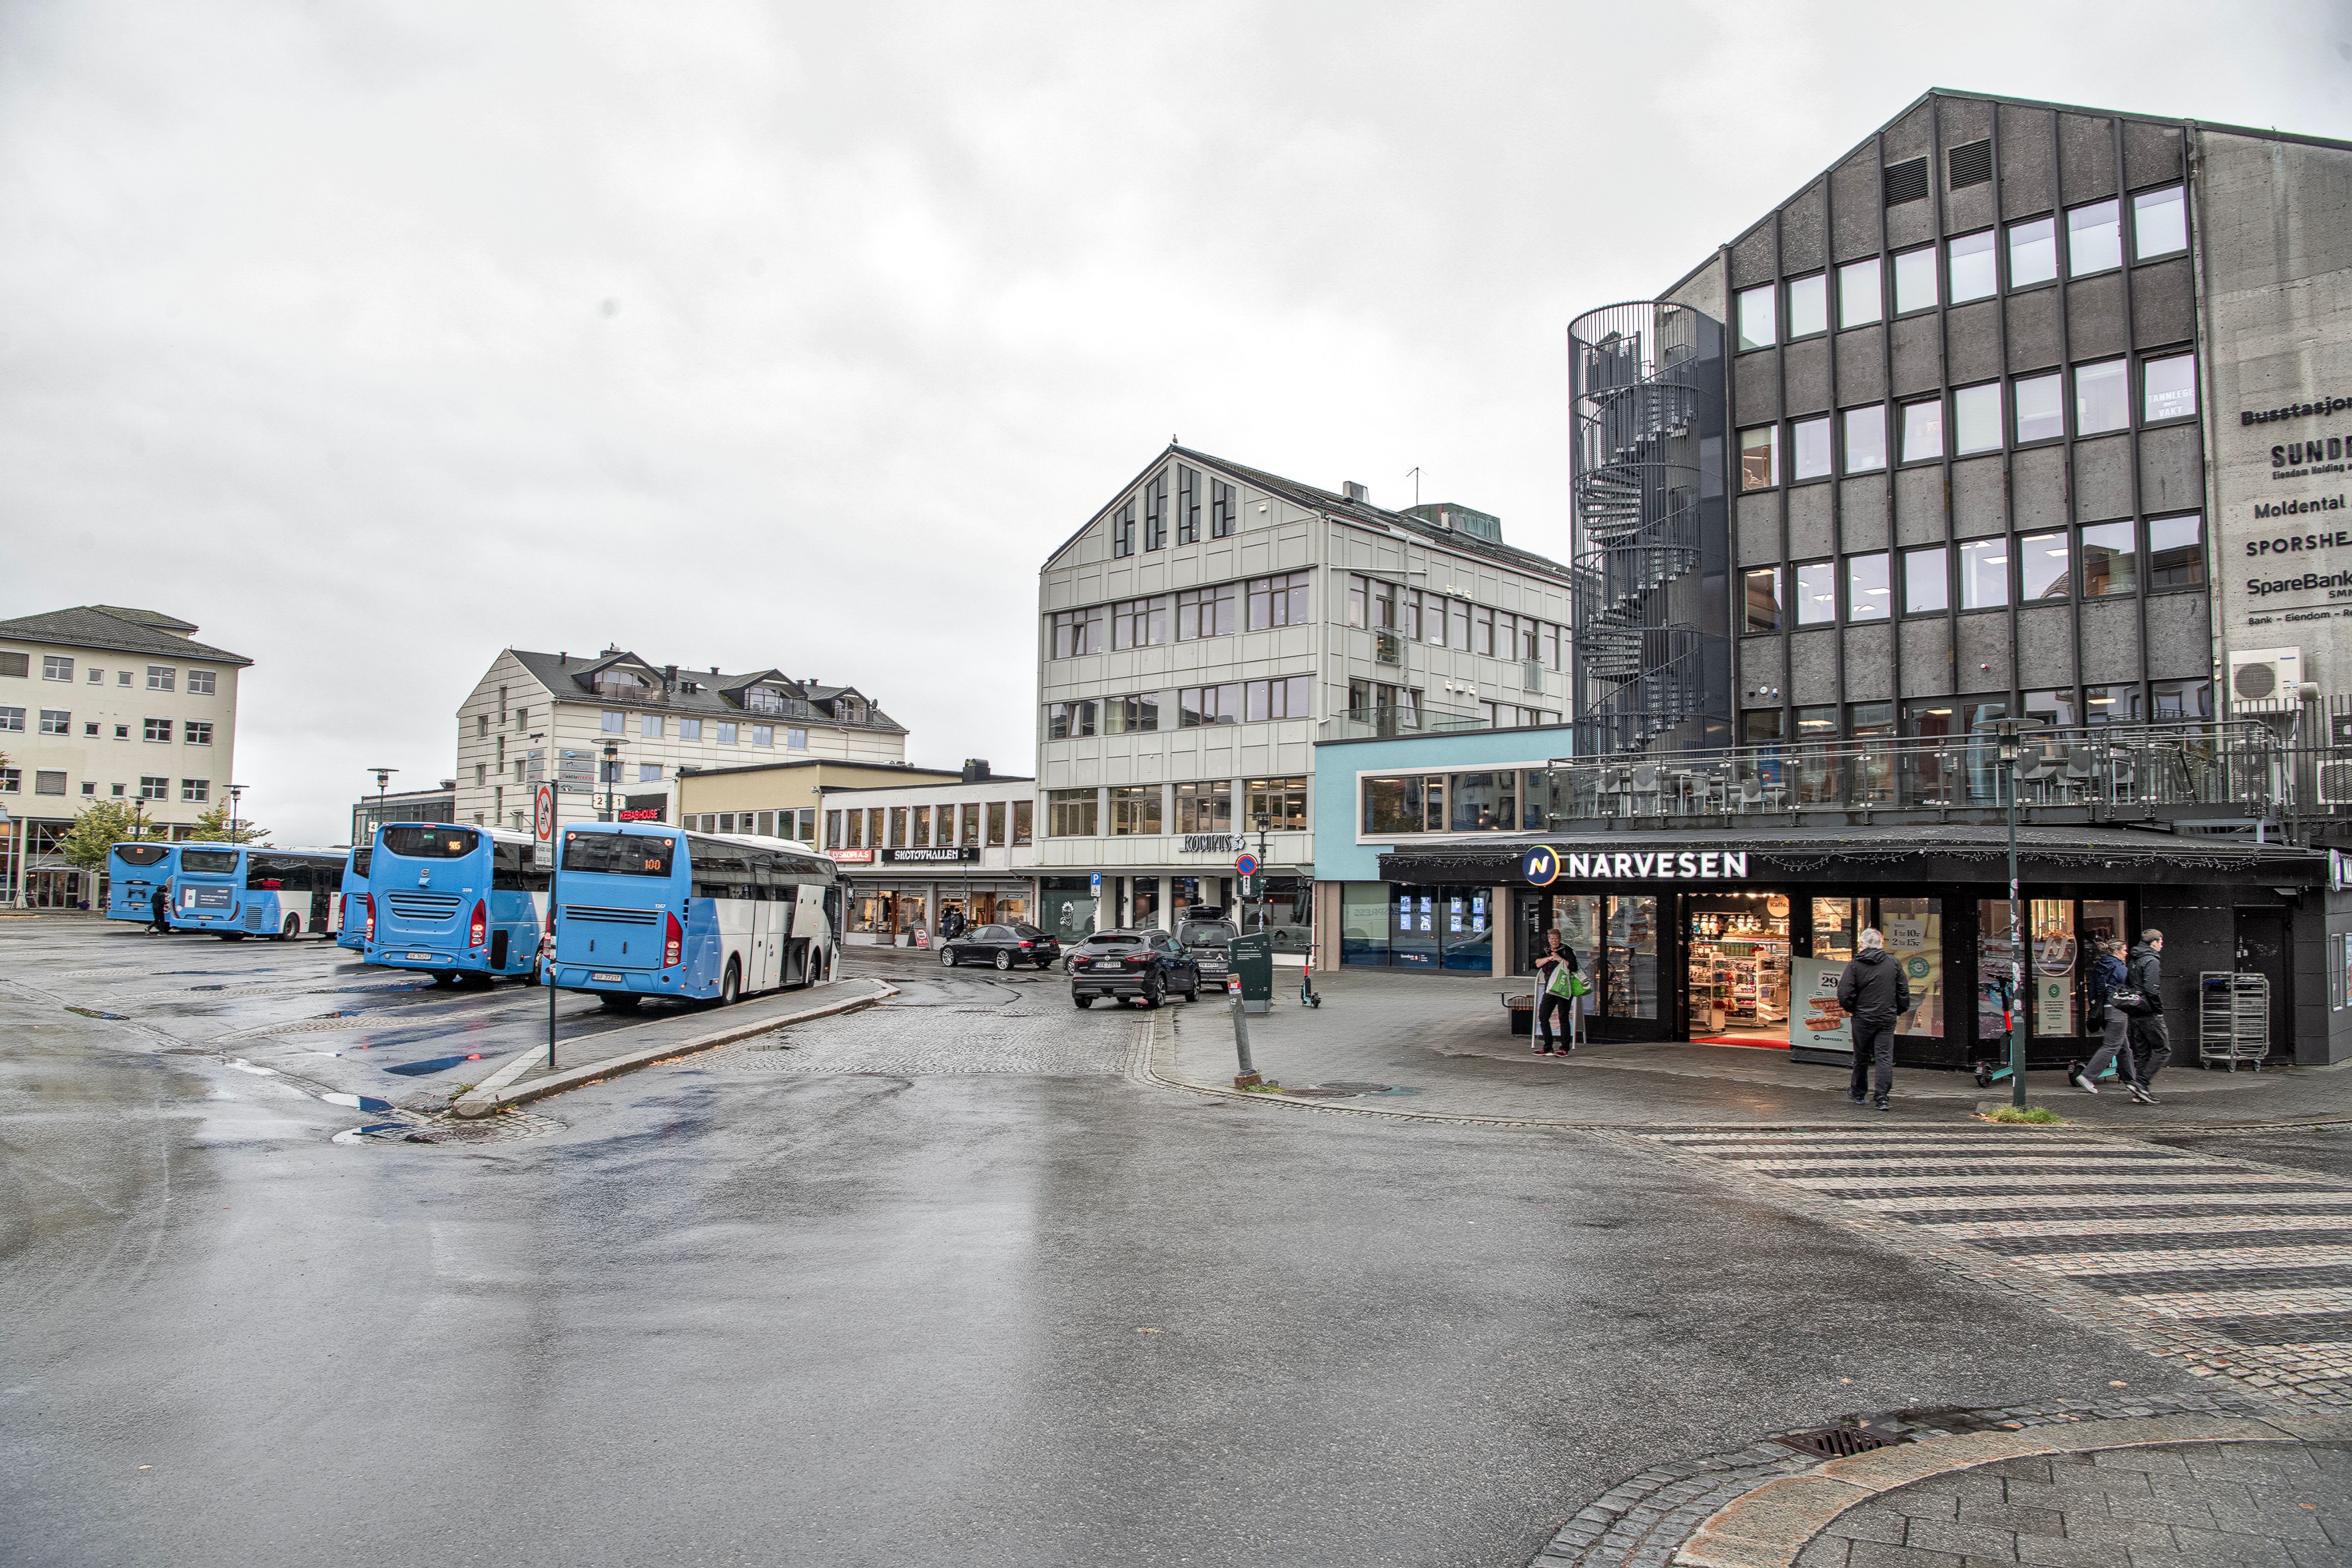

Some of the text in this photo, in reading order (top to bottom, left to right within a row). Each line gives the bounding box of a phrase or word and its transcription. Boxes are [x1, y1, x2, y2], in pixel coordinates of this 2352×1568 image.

[2147, 387, 2195, 403] TANNLEGE
[2159, 405, 2183, 417] VAKT
[2311, 463, 2344, 474] Holding
[2255, 494, 2346, 518] Moldental
[2246, 570, 2352, 596] SpareBank
[2248, 616, 2272, 624] Bank
[2285, 612, 2330, 621] Eiendom
[449, 841, 461, 850] 905
[1184, 834, 1231, 852] KOMPIS
[895, 849, 958, 860] SKOTØYHALLEN
[645, 859, 661, 870] 100
[1569, 851, 1747, 878] NARVESEN
[1093, 874, 1099, 884] P
